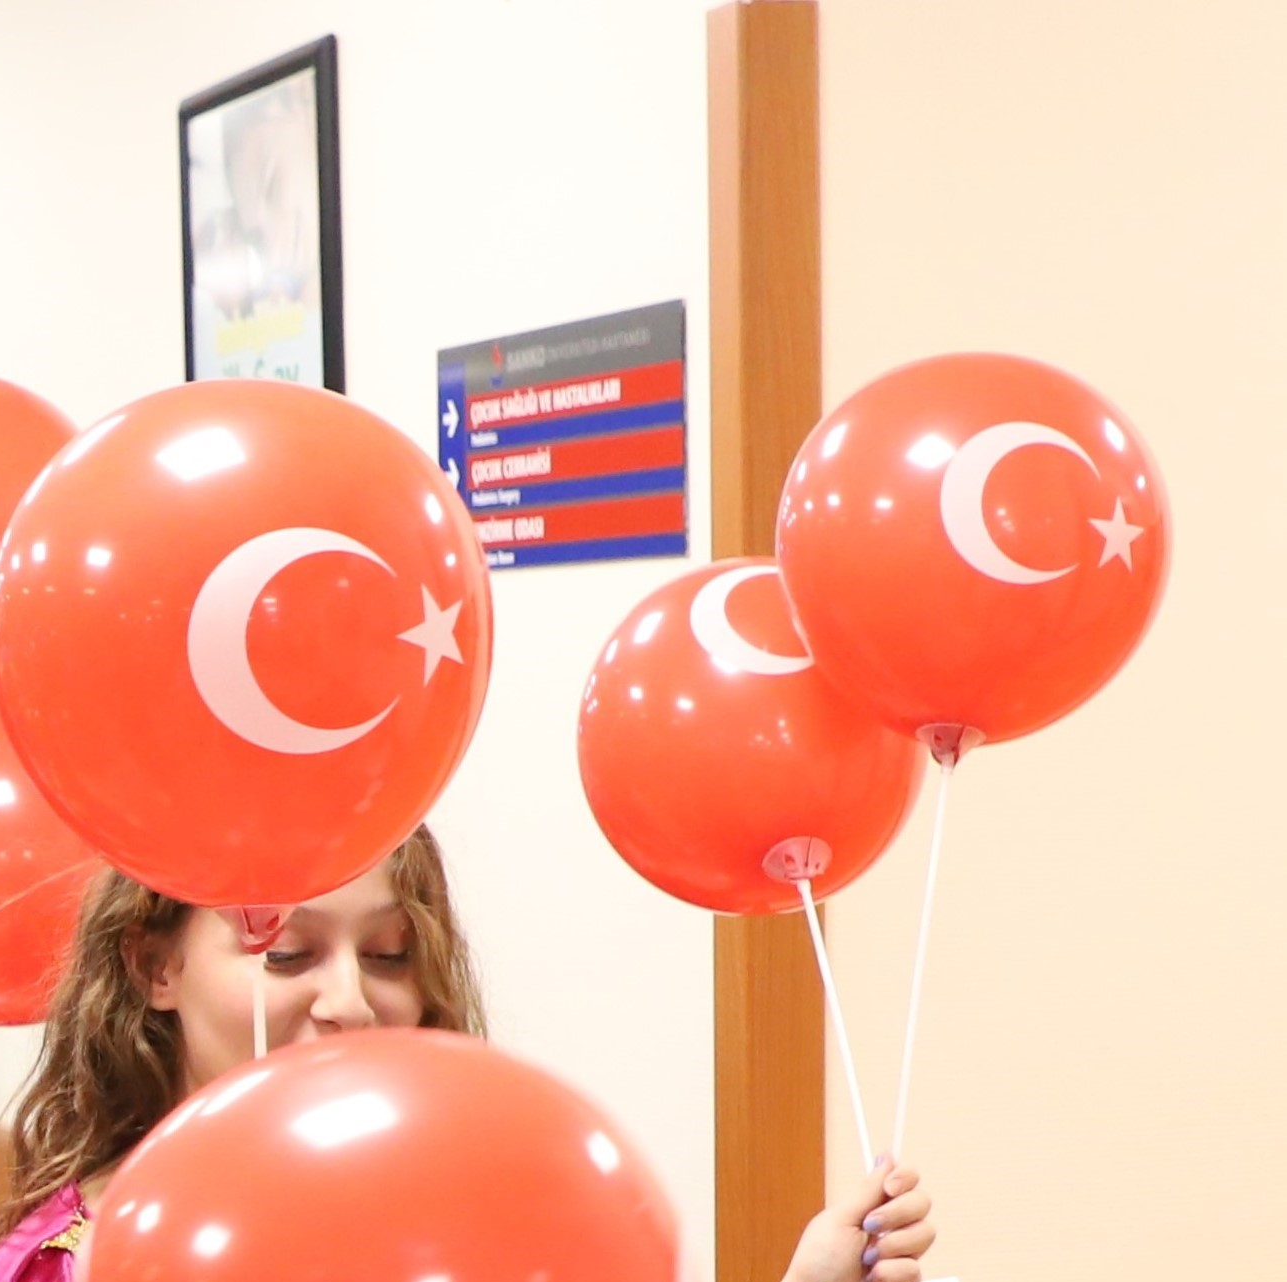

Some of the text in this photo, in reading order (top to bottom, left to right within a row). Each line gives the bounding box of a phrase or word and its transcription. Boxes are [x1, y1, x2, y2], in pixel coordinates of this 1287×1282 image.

[470, 379, 621, 429] ÇOCUK SAĞLIĞI VE HASTALIKLARI
[471, 447, 551, 488] ÇOCUK CERRAHİSİ
[474, 515, 545, 543] MZİRME ODASI
